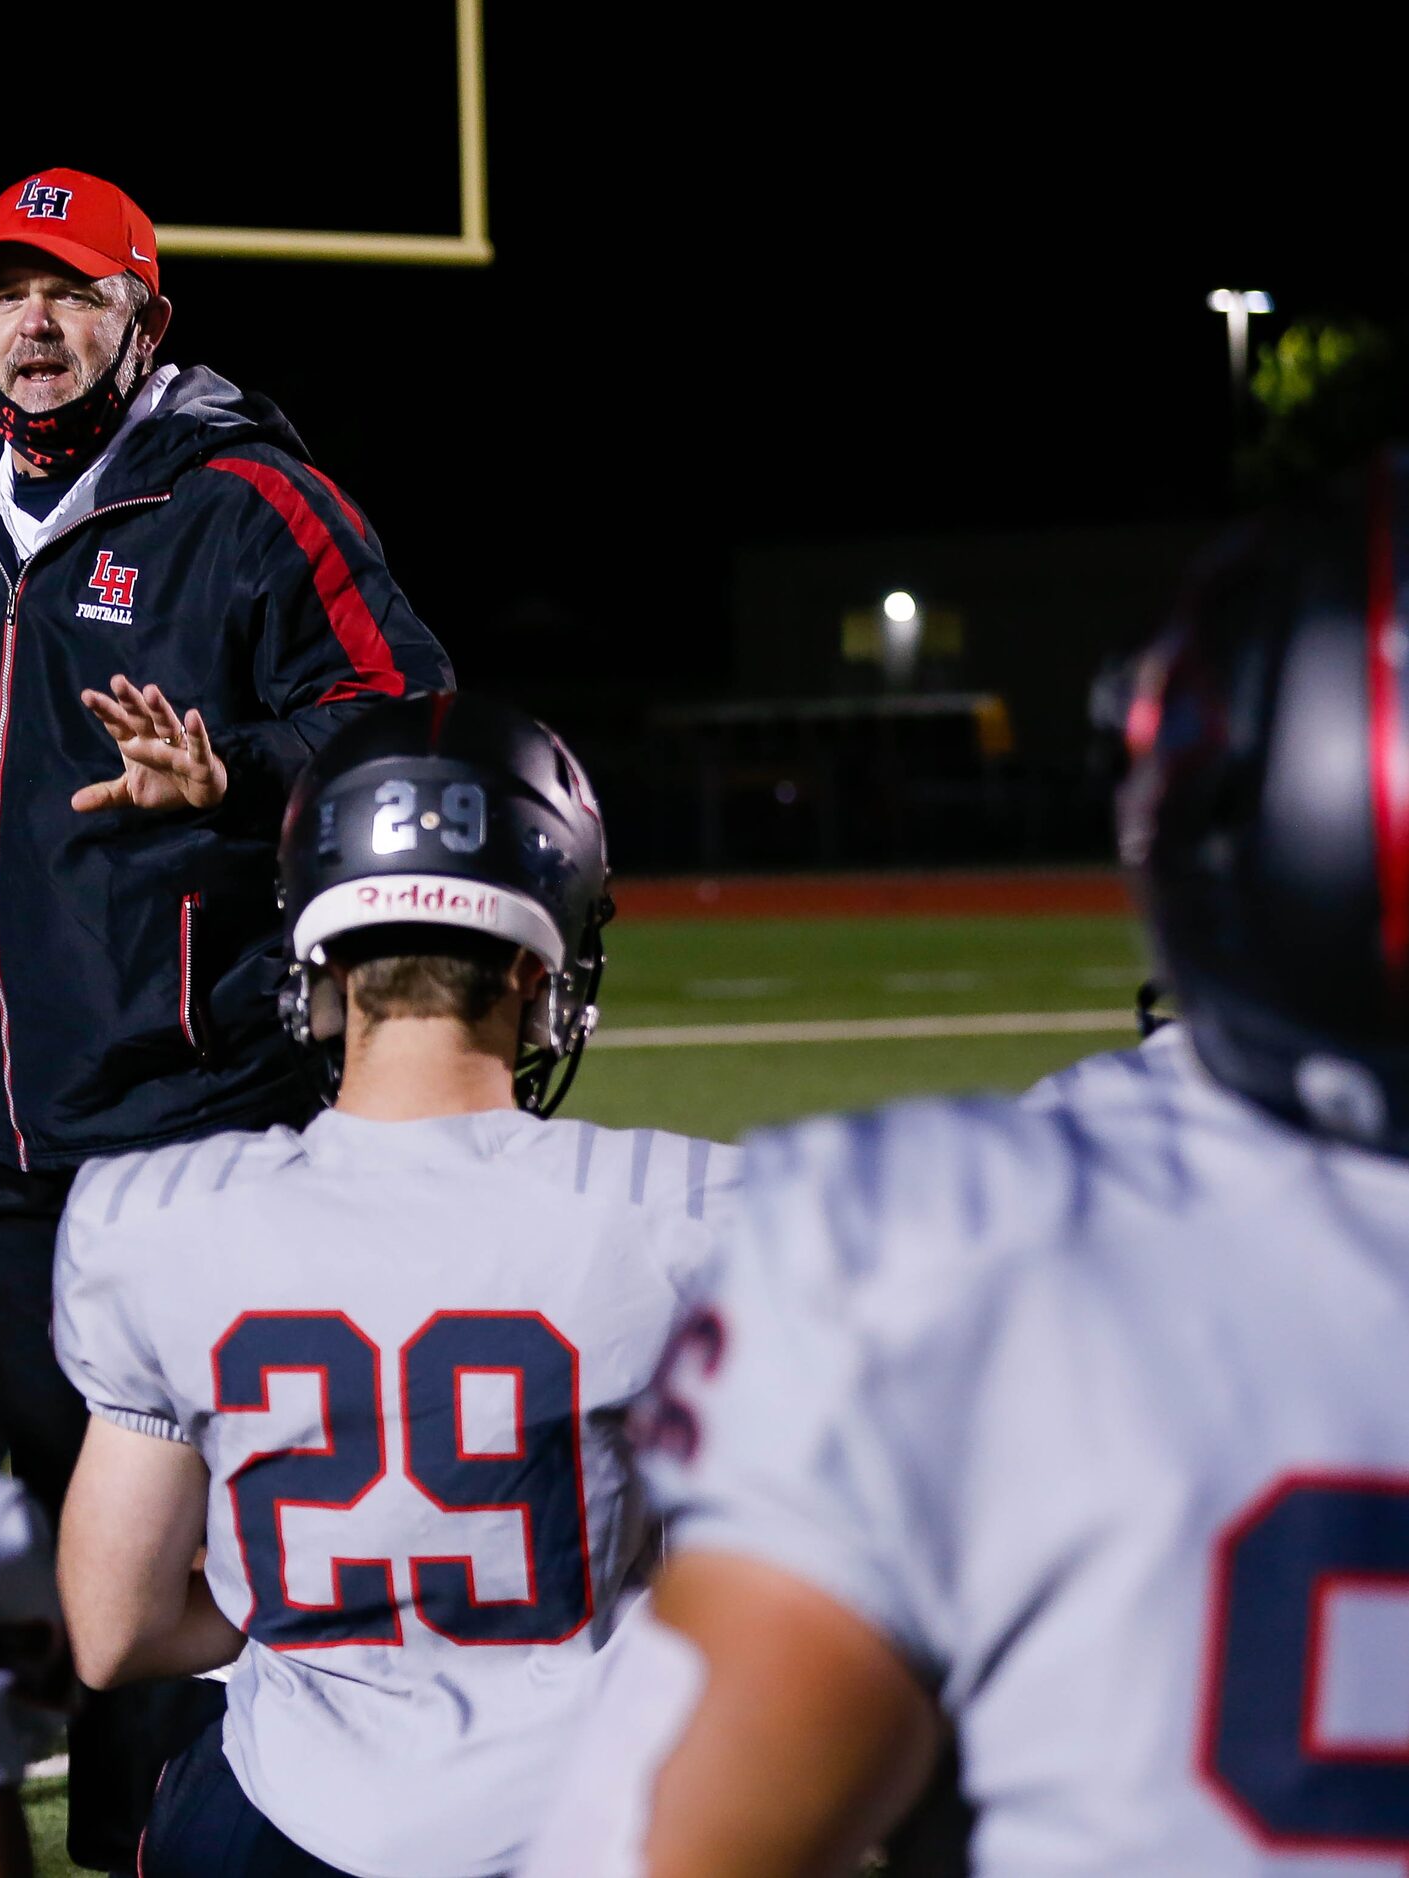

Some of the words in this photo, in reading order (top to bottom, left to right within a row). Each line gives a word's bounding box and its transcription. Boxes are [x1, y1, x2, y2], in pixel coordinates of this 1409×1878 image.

[16, 178, 72, 221] LH
[88, 550, 138, 607] LH
[76, 603, 133, 625] FOOTBALL
[372, 779, 486, 854] 29
[357, 883, 498, 922] Riddell
[211, 1310, 594, 1653] 29
